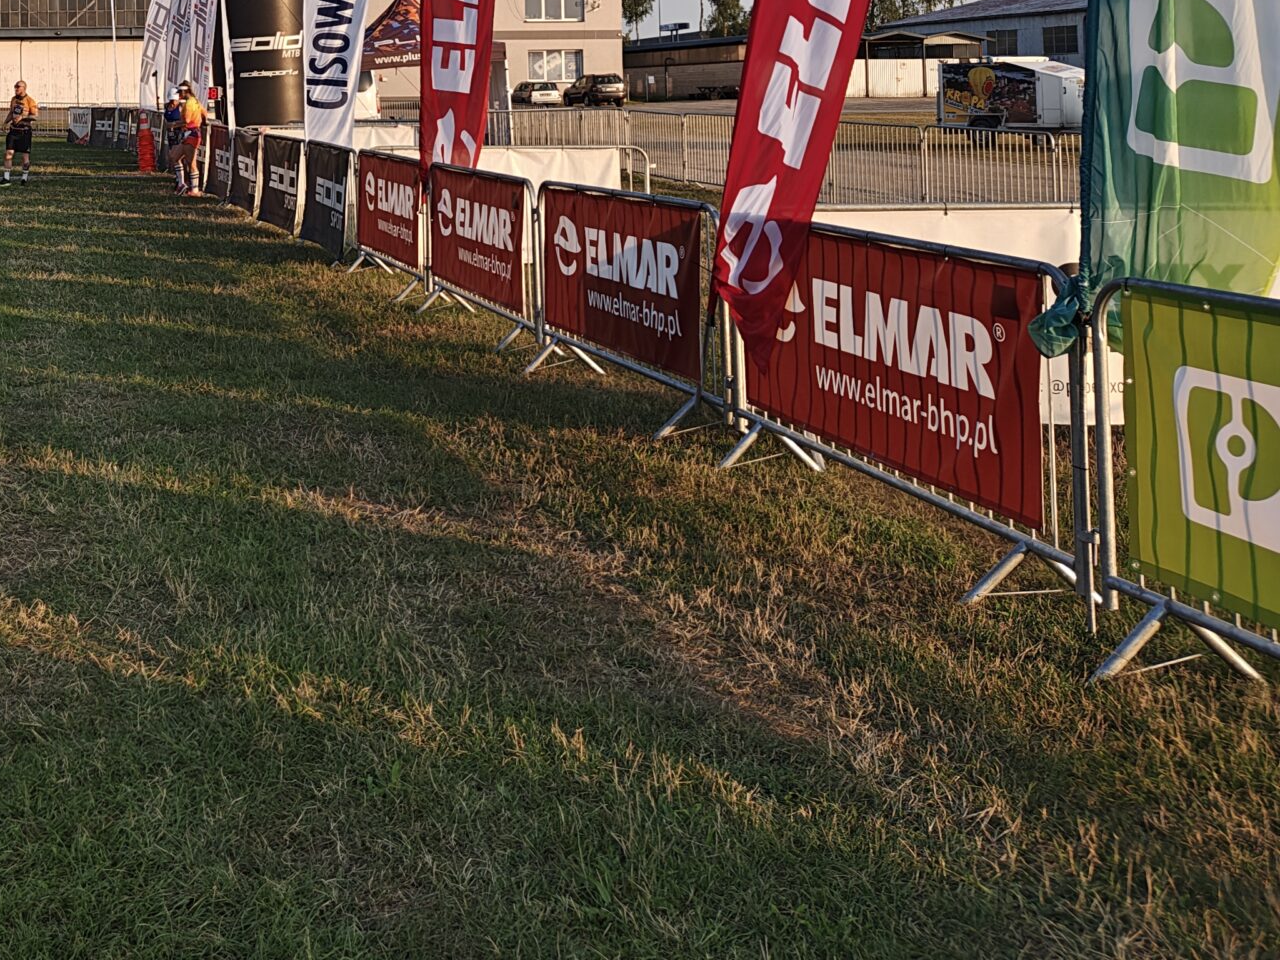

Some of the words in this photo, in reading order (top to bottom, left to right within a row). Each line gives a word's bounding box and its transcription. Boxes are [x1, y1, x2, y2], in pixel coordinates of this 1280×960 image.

[140, 1, 170, 86] solid
[231, 30, 304, 52] solid
[282, 49, 301, 58] MTB
[586, 287, 683, 341] www.elmar-bhp.pl
[815, 364, 999, 459] www.elmar-bhp.pl
